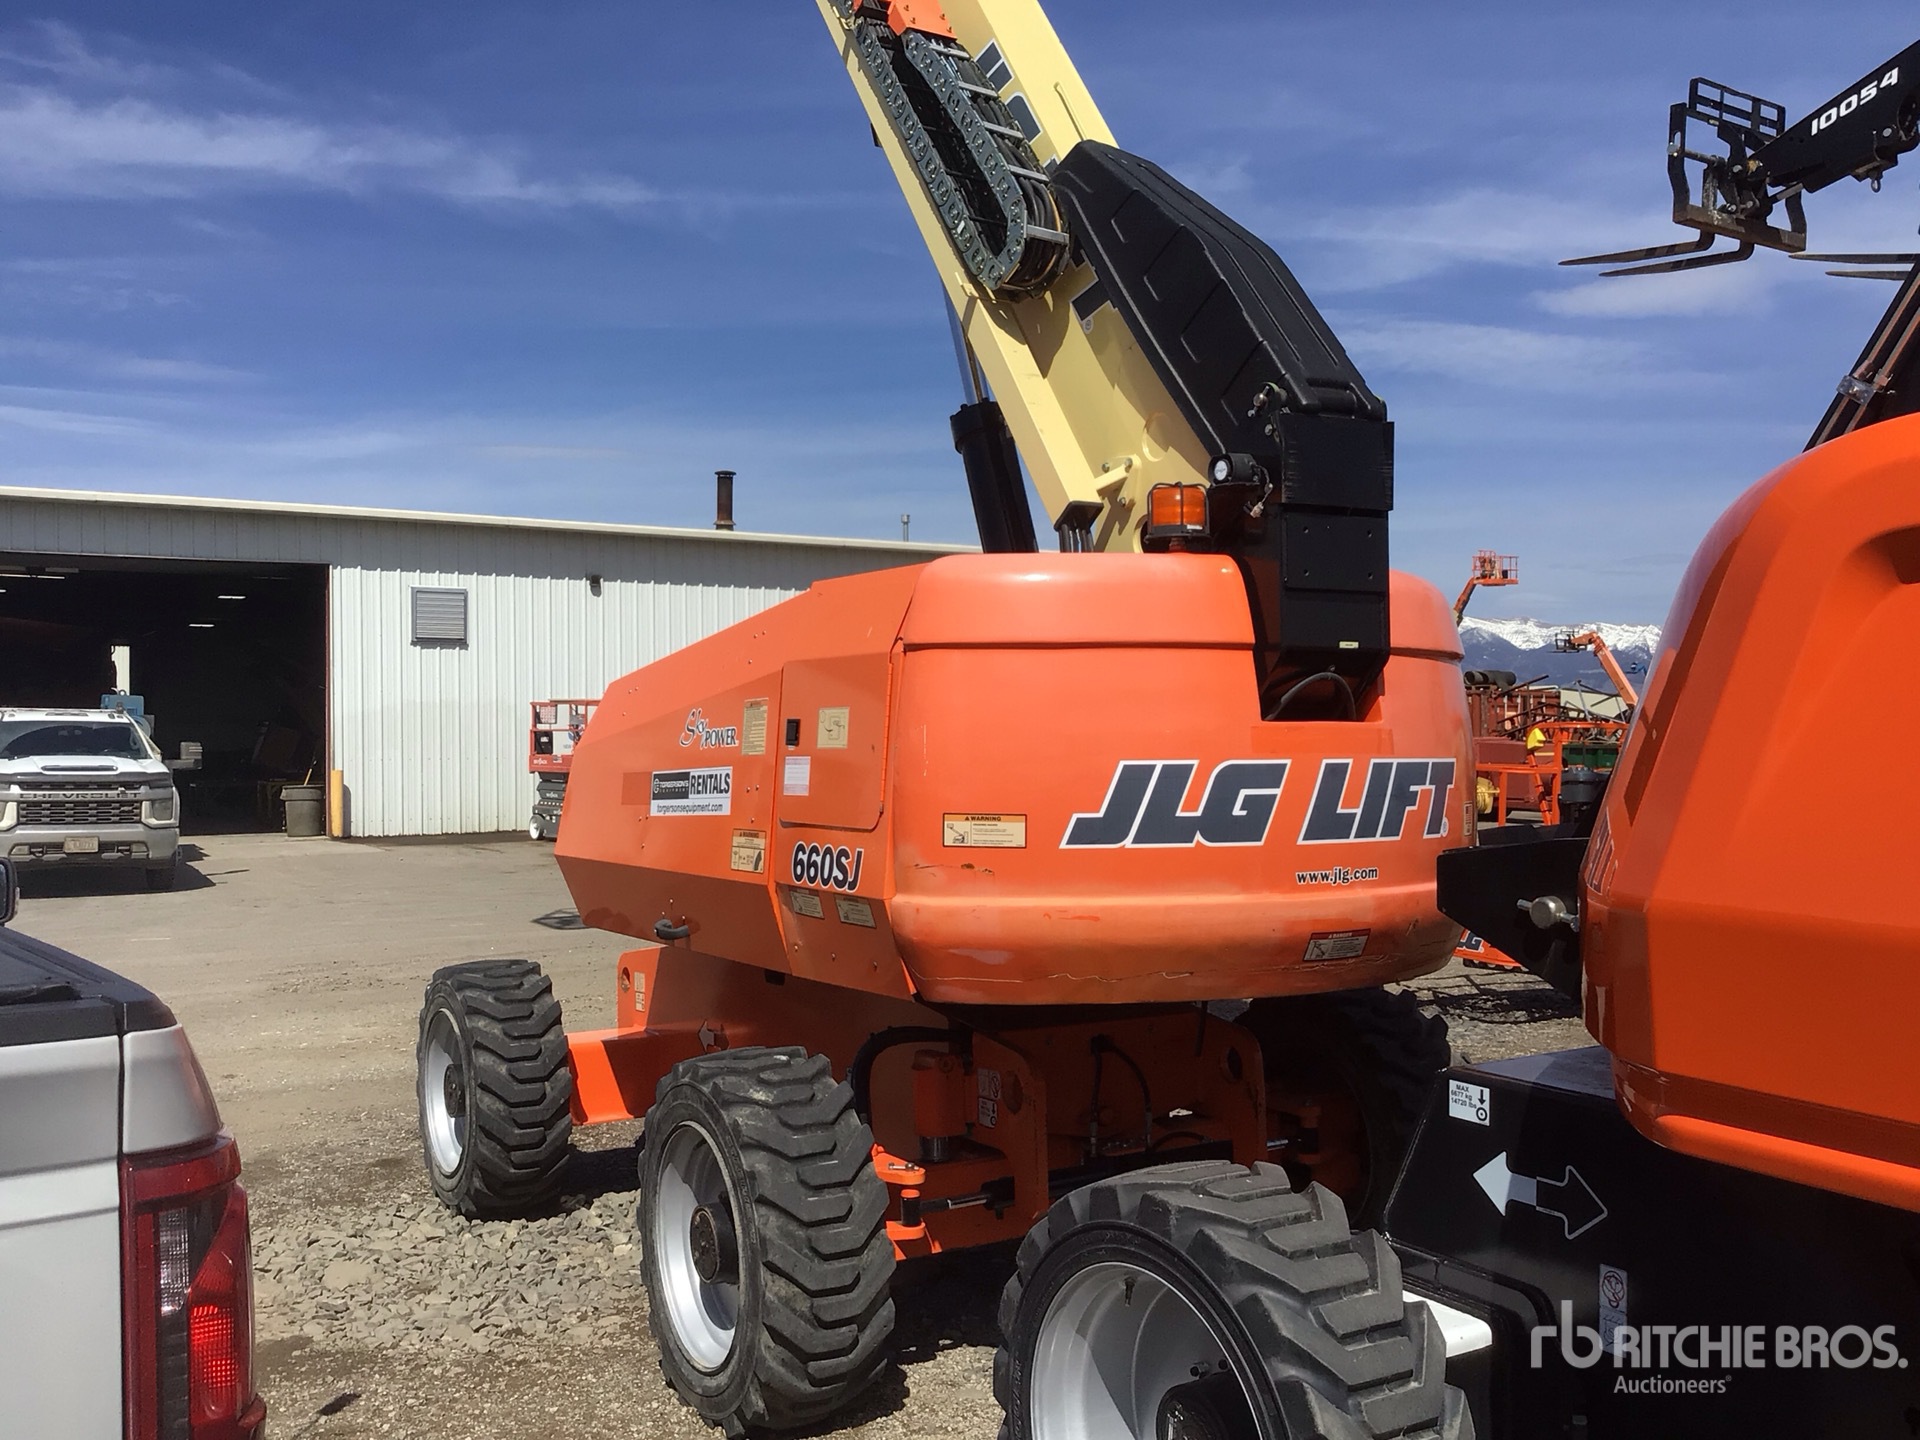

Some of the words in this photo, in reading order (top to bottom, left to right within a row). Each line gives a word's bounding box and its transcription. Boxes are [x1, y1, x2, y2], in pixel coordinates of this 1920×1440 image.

[1811, 66, 1899, 136] 10054
[703, 727, 738, 748] POWER
[690, 772, 731, 795] RENTALS
[657, 802, 723, 814] torgersonsequipment.com
[1058, 759, 1291, 849] JLG
[1296, 758, 1457, 845] LIFT
[792, 842, 864, 893] 660SJ
[1296, 867, 1378, 885] www.jlg.com
[1456, 1084, 1470, 1092] MAX
